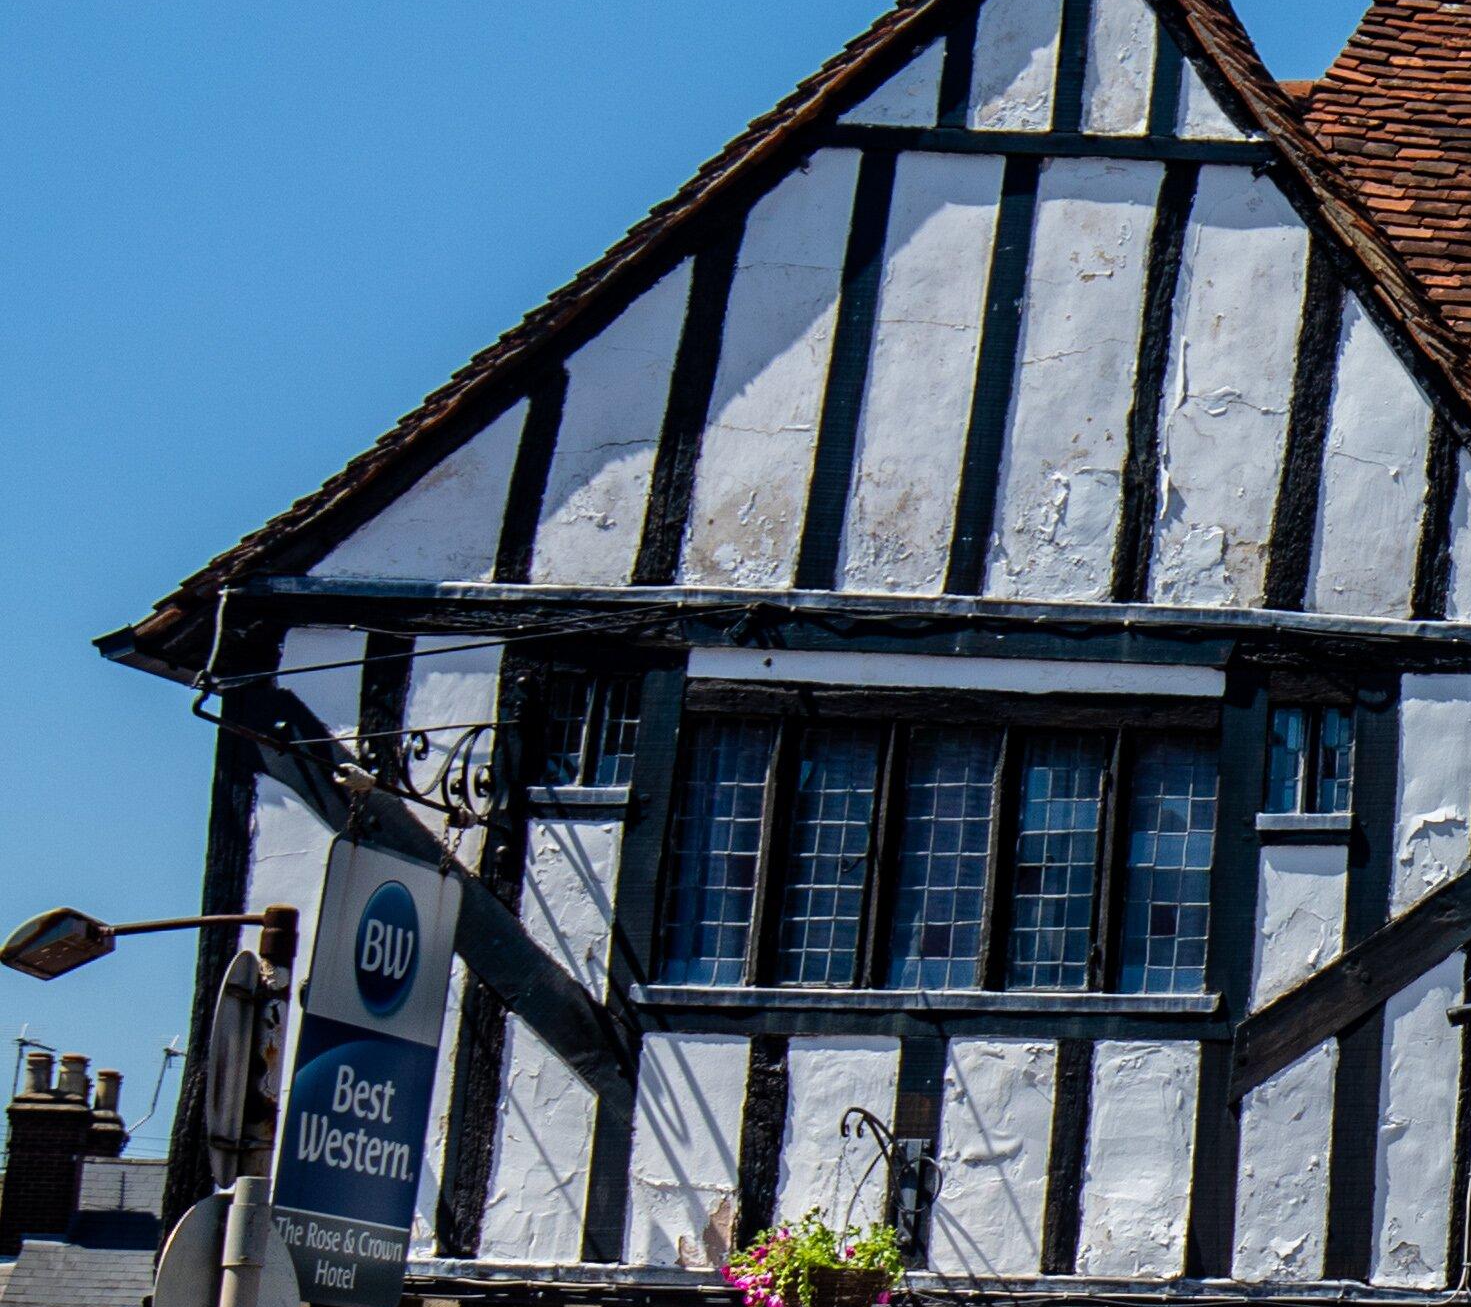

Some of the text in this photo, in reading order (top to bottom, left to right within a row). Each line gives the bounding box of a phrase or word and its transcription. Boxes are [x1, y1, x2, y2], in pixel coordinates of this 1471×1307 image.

[361, 918, 414, 980] BW
[332, 1064, 396, 1124] Best
[276, 1215, 403, 1262] The Rose & Crown
[314, 1259, 358, 1290] Hotel
